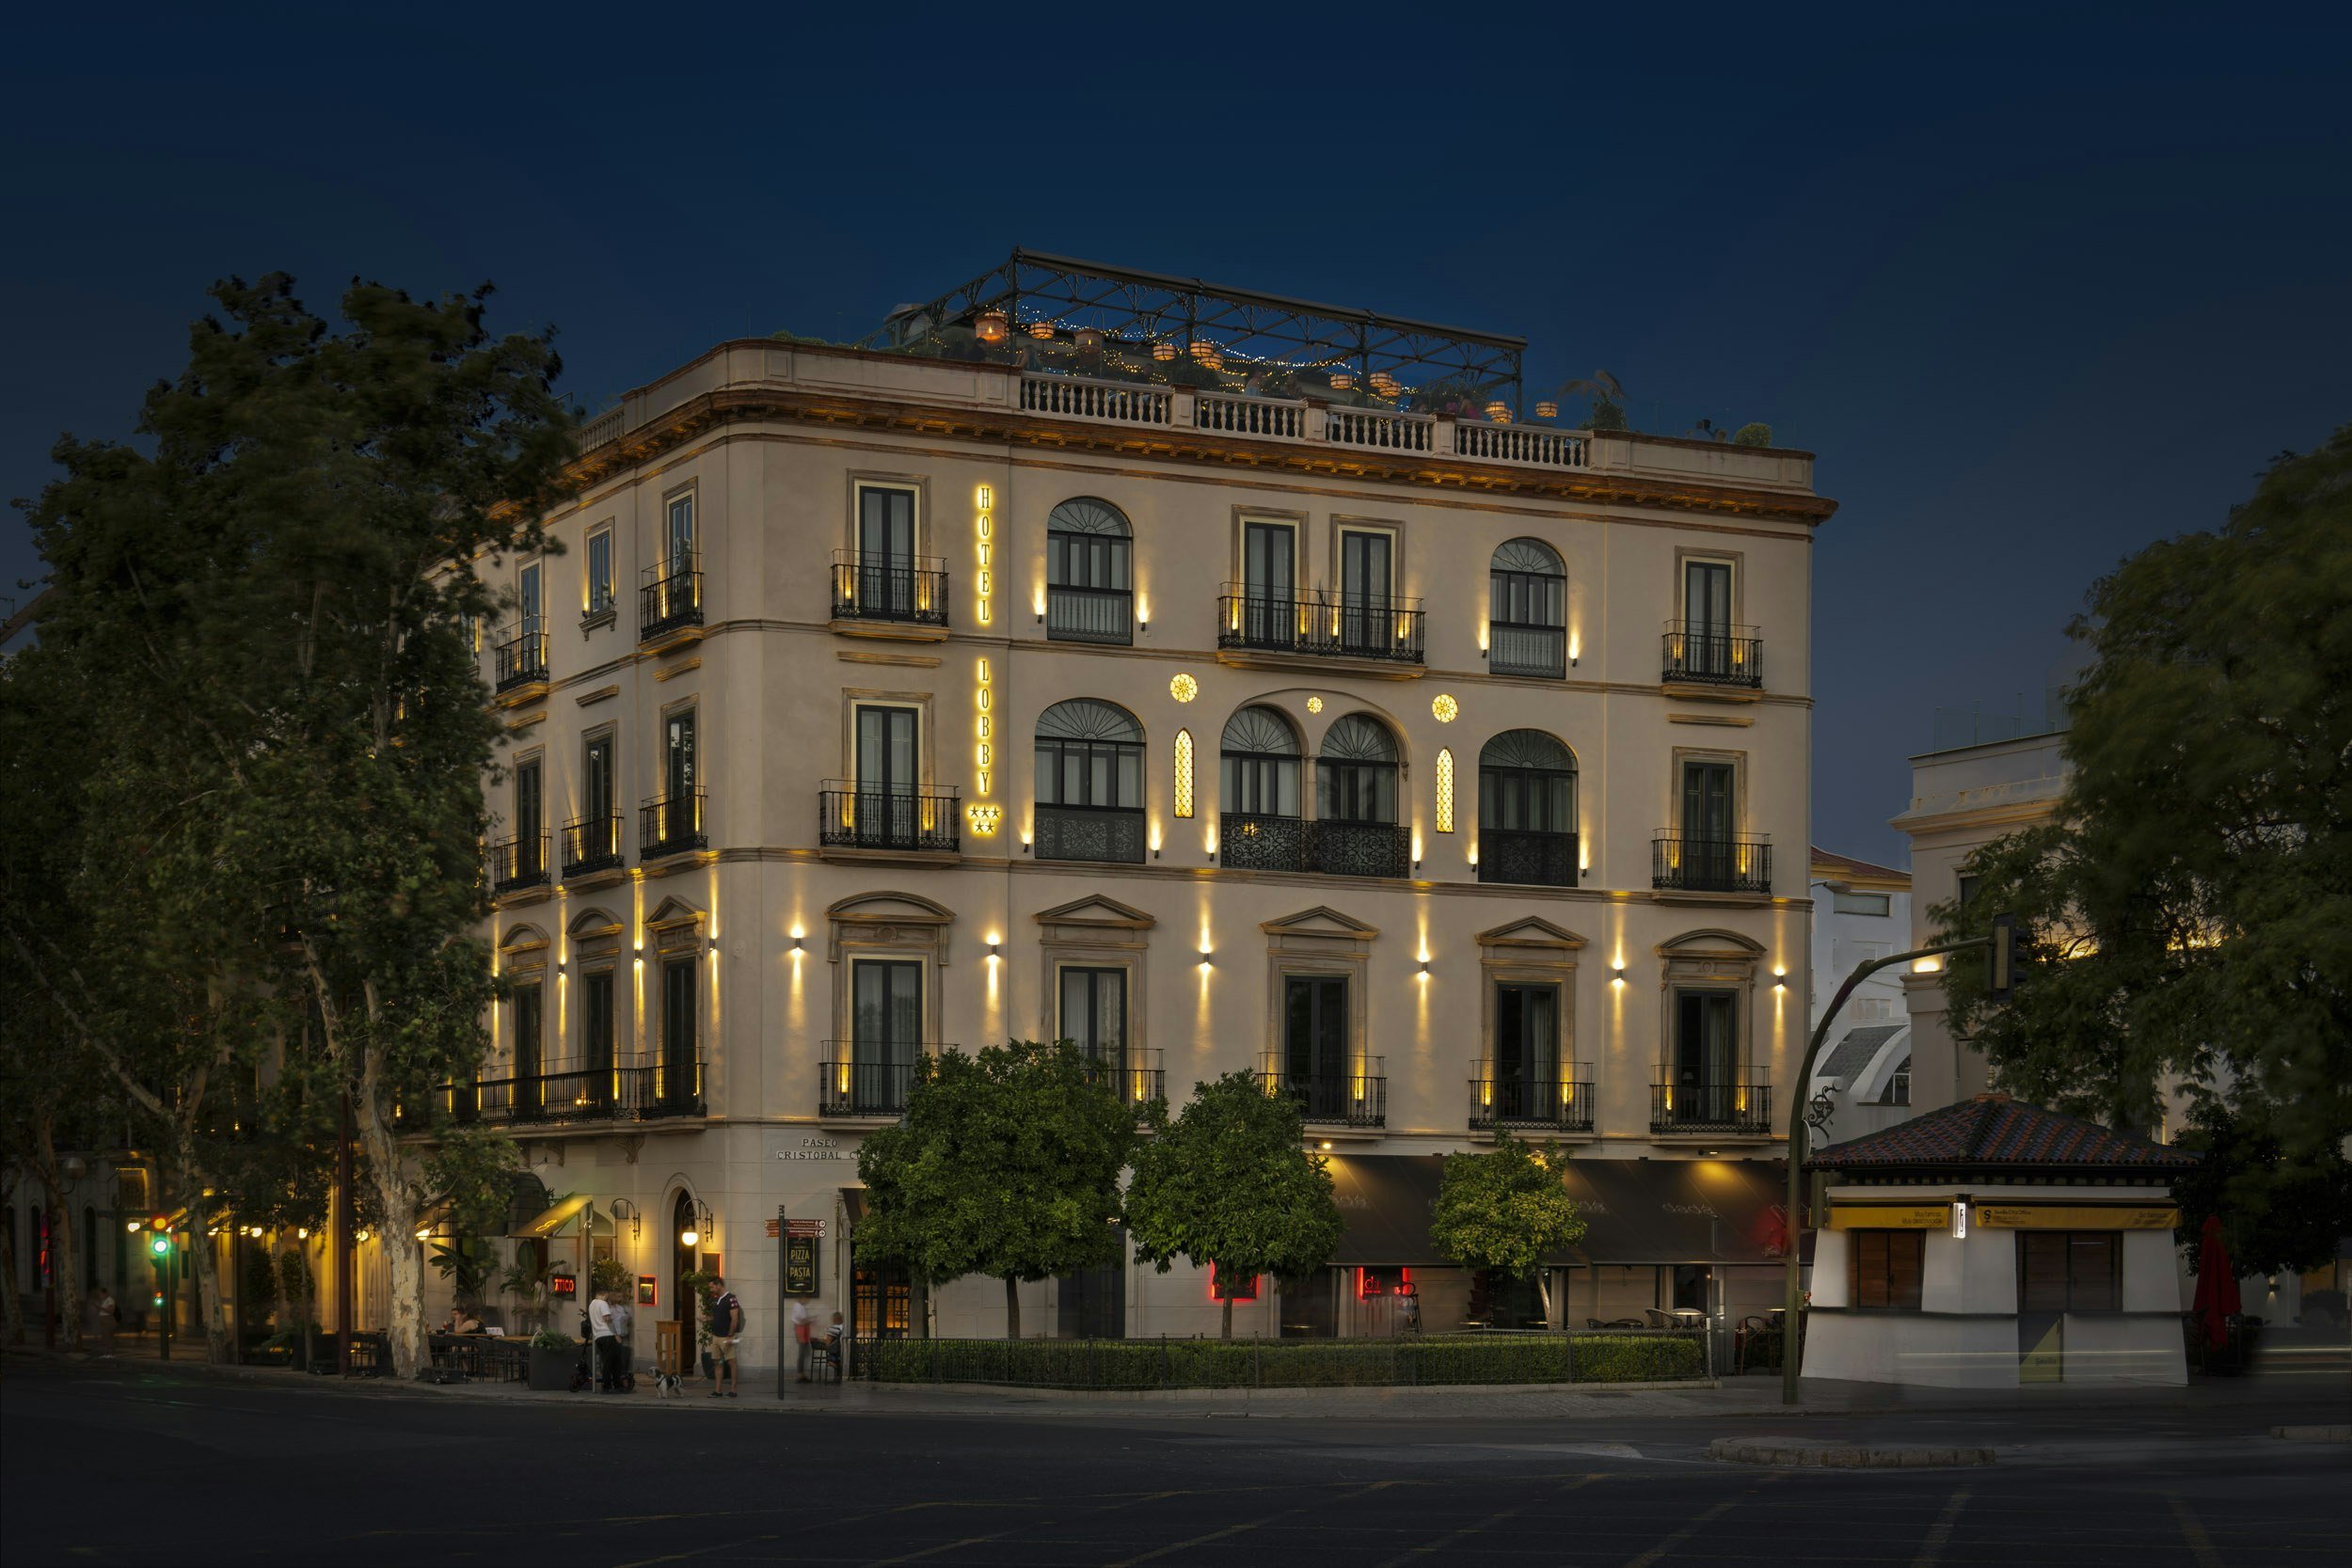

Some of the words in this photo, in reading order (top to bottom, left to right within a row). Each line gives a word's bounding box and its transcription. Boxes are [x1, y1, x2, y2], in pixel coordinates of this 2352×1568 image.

[980, 487, 991, 621] HOTEL
[980, 660, 990, 793] LOBBY
[803, 1138, 838, 1148] PASEO
[777, 1151, 841, 1160] CRISTOBAL
[790, 1249, 810, 1260] PIZZA
[789, 1267, 811, 1277] PASTA
